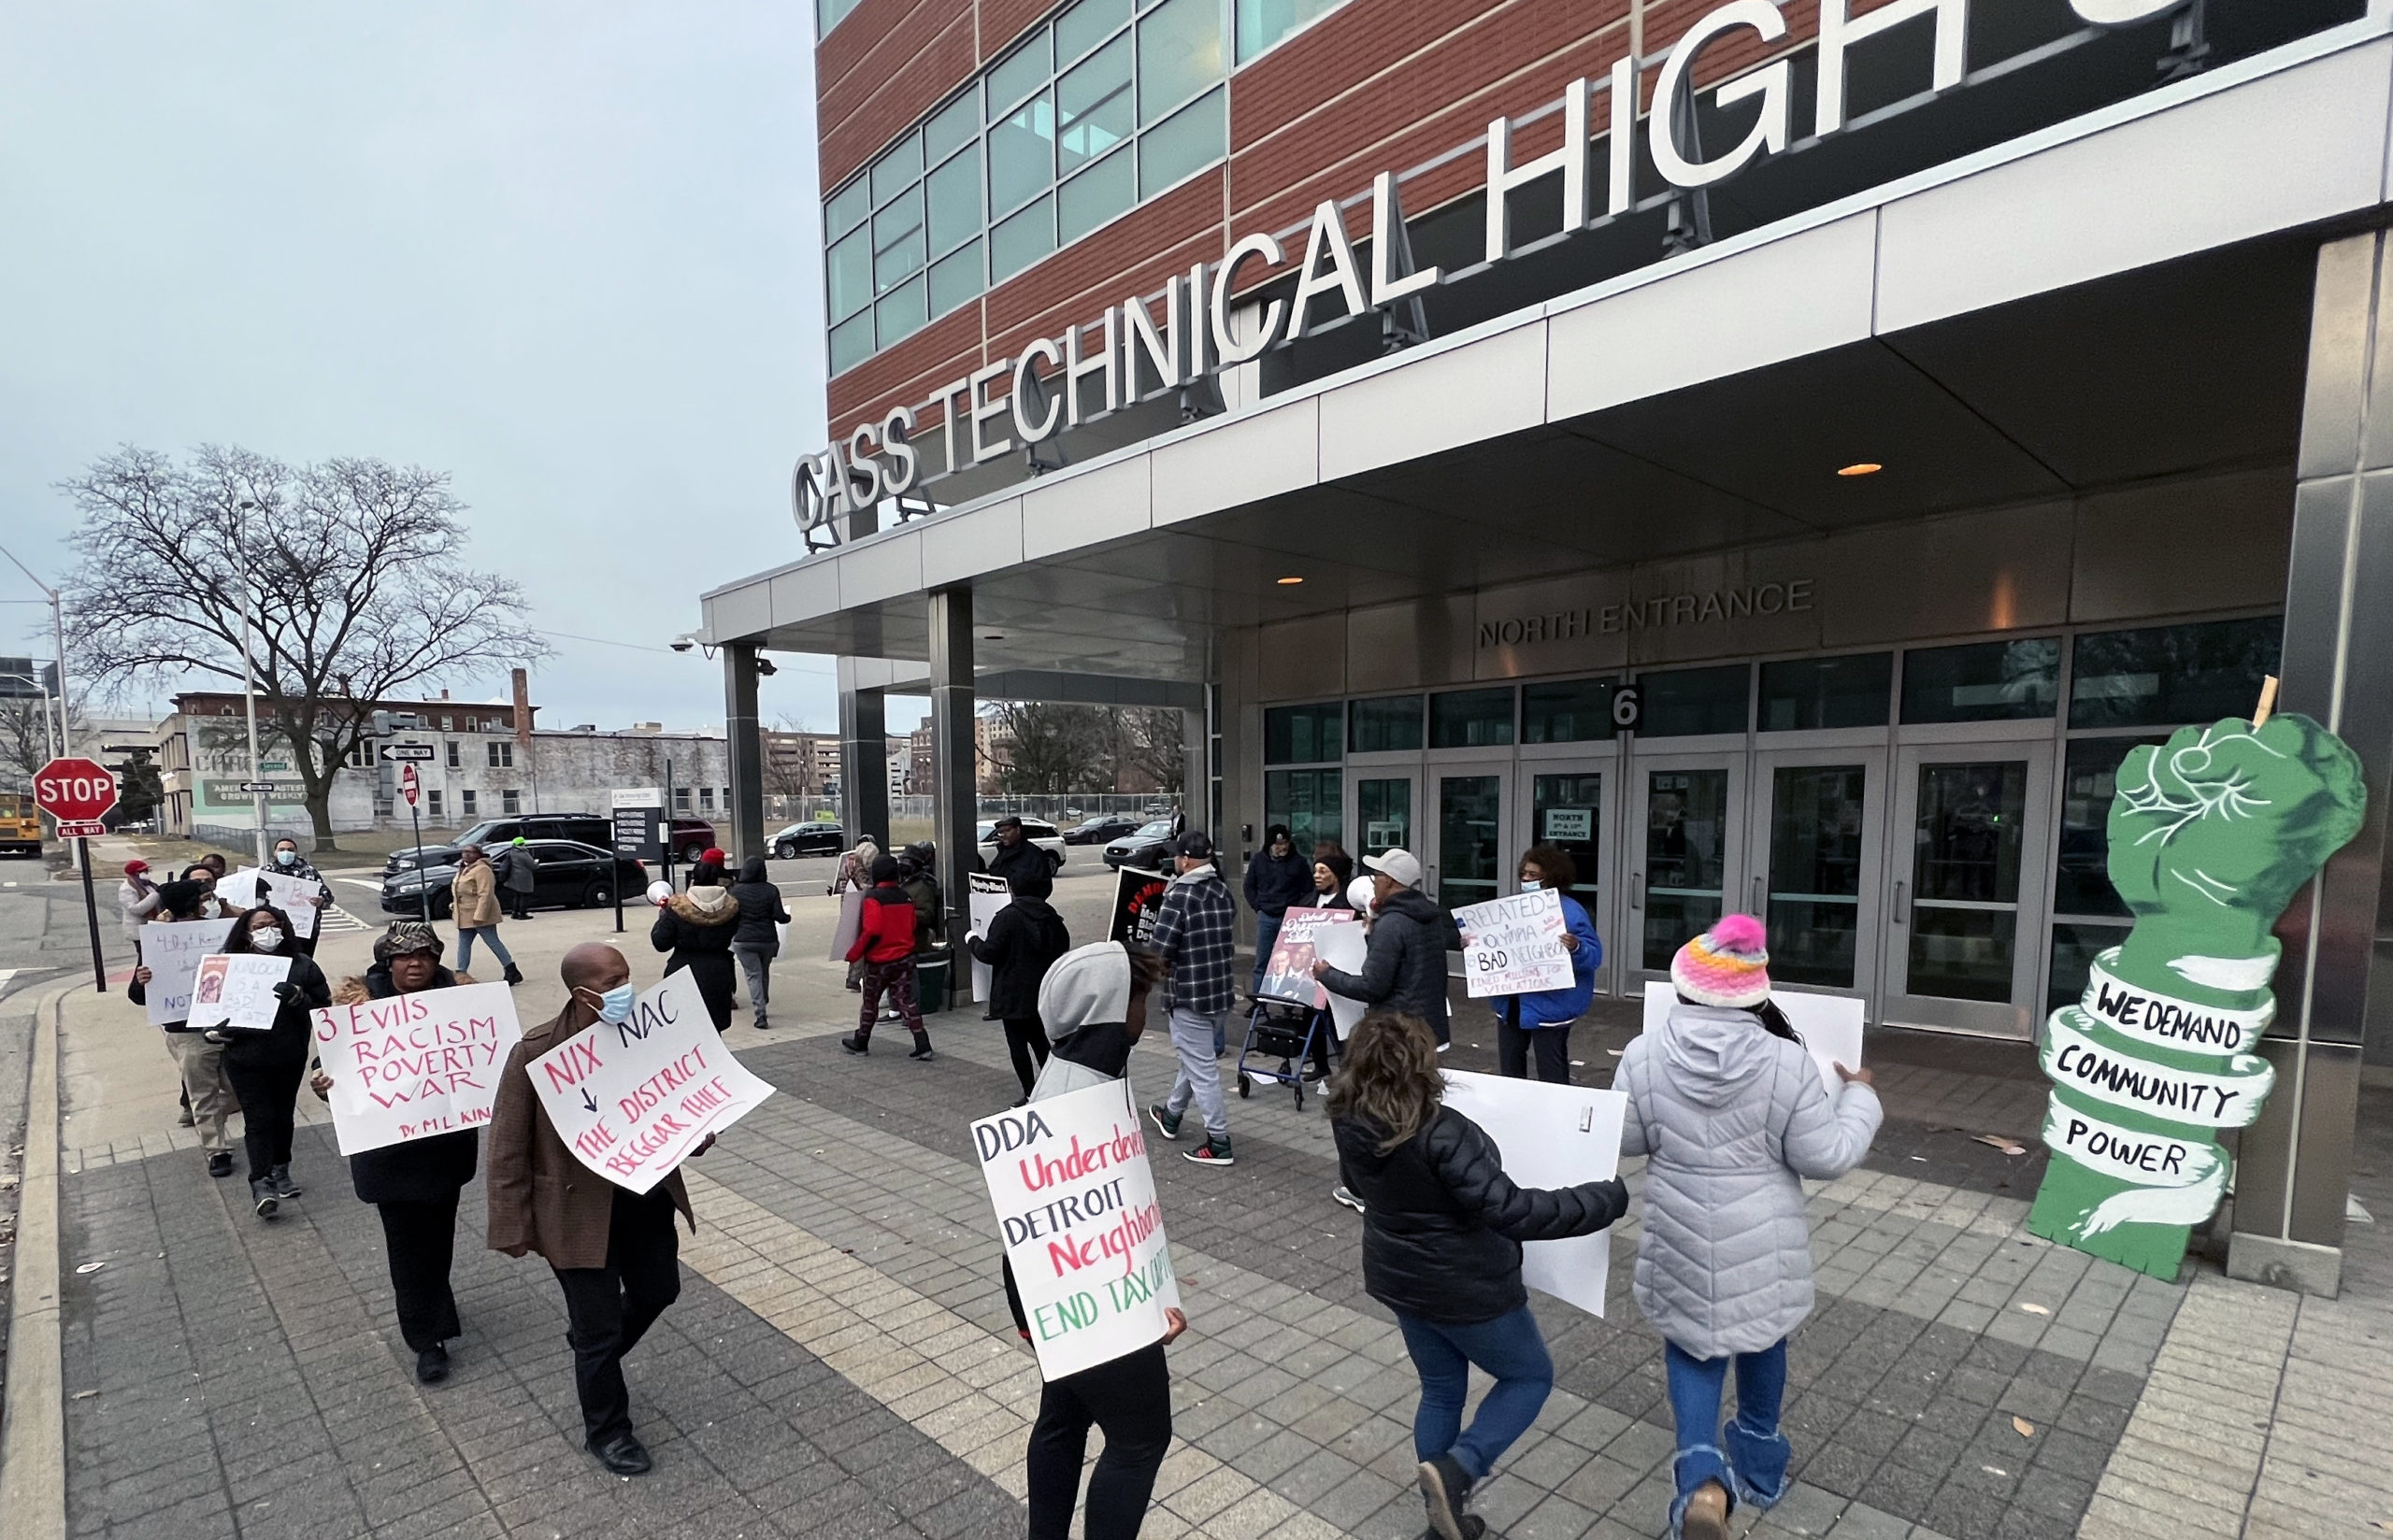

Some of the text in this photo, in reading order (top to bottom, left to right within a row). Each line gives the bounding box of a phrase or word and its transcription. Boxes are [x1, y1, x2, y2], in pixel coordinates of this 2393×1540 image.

[791, 0, 1969, 532] CASS TECHNICAL HIGH
[1480, 578, 1815, 648] NORTH ENTRANCE
[1612, 690, 1637, 725] 6
[40, 777, 111, 804] STOP
[61, 824, 101, 836] ALL WAY
[1462, 894, 1545, 931] RELATED
[1477, 950, 1508, 972] BAD
[1484, 977, 1554, 994] VIOLATIONS
[317, 1007, 337, 1042] 3
[350, 1016, 496, 1064] RACISM
[2097, 981, 2241, 1049] WE DEMAND
[356, 1040, 498, 1088] POVERTY
[543, 990, 679, 1094] NIX NAC
[369, 1071, 485, 1109] WAR
[575, 1043, 708, 1160] THE DISTRICT
[2056, 1044, 2240, 1119] COMMUNITY
[460, 1106, 492, 1124] KIN
[606, 1075, 732, 1177] BEGGAR THIEF
[975, 1110, 1054, 1162] DDA
[2066, 1119, 2186, 1175] POWER
[1003, 1176, 1125, 1248] DETROIT
[1034, 1291, 1098, 1342] END
[1101, 1265, 1153, 1314] TAX
